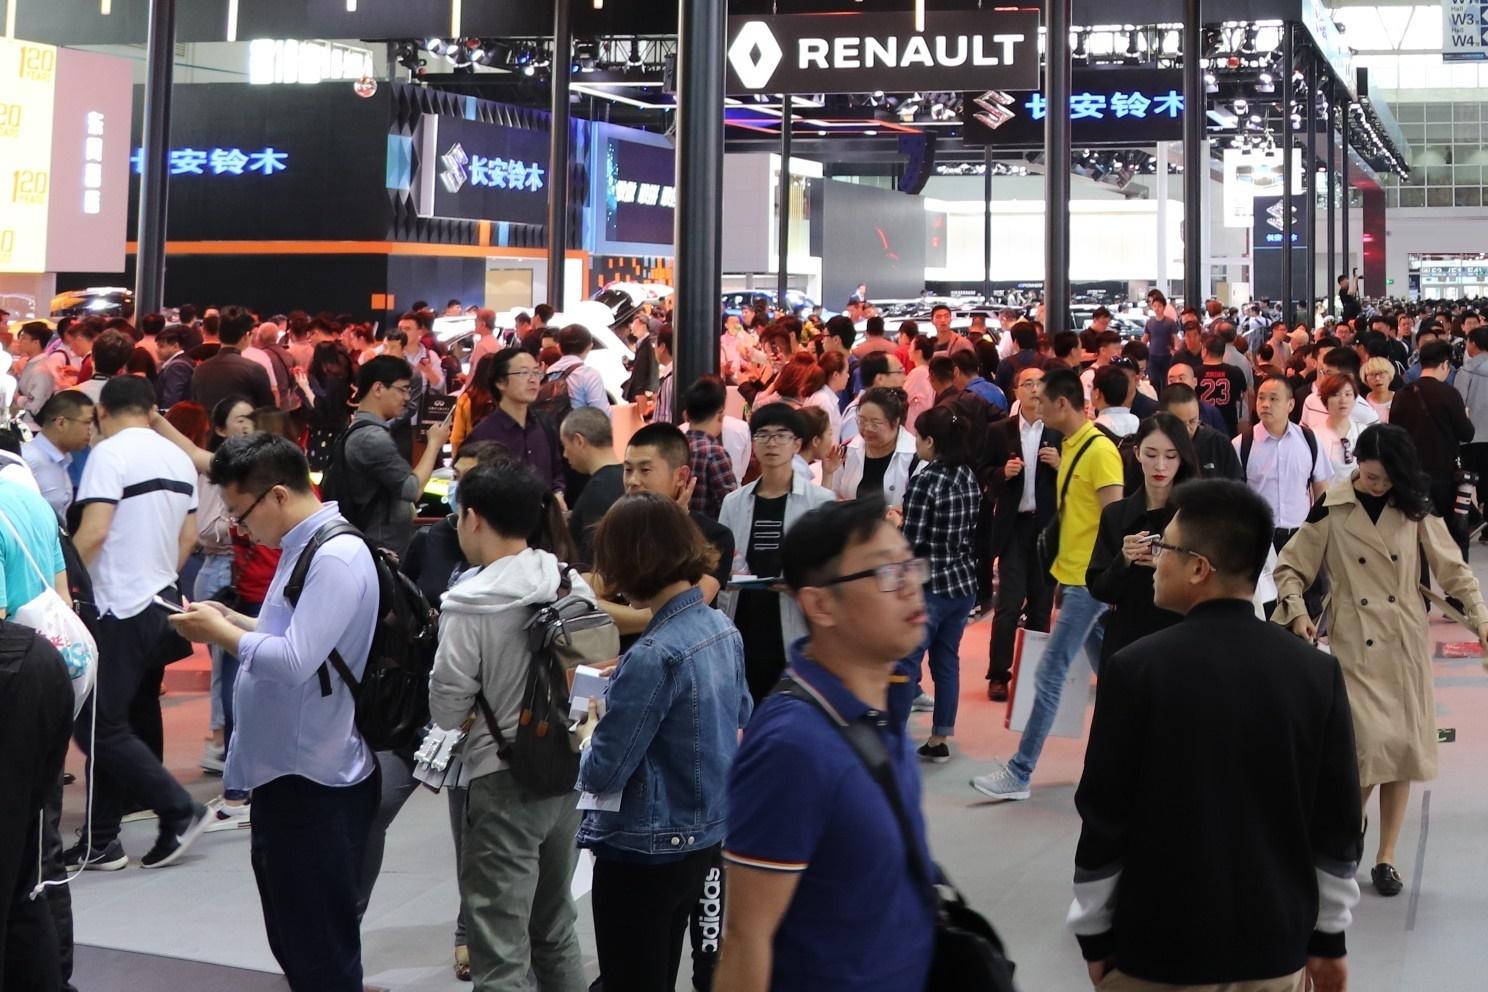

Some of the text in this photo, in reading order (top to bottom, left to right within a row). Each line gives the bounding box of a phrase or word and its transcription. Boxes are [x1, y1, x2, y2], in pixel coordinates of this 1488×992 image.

[1452, 14, 1474, 25] W3
[798, 34, 1024, 69] RENAULT
[1452, 35, 1475, 47] W4
[468, 155, 545, 192] 长安铃木
[1200, 378, 1230, 406] 23
[699, 867, 720, 953] adidas
